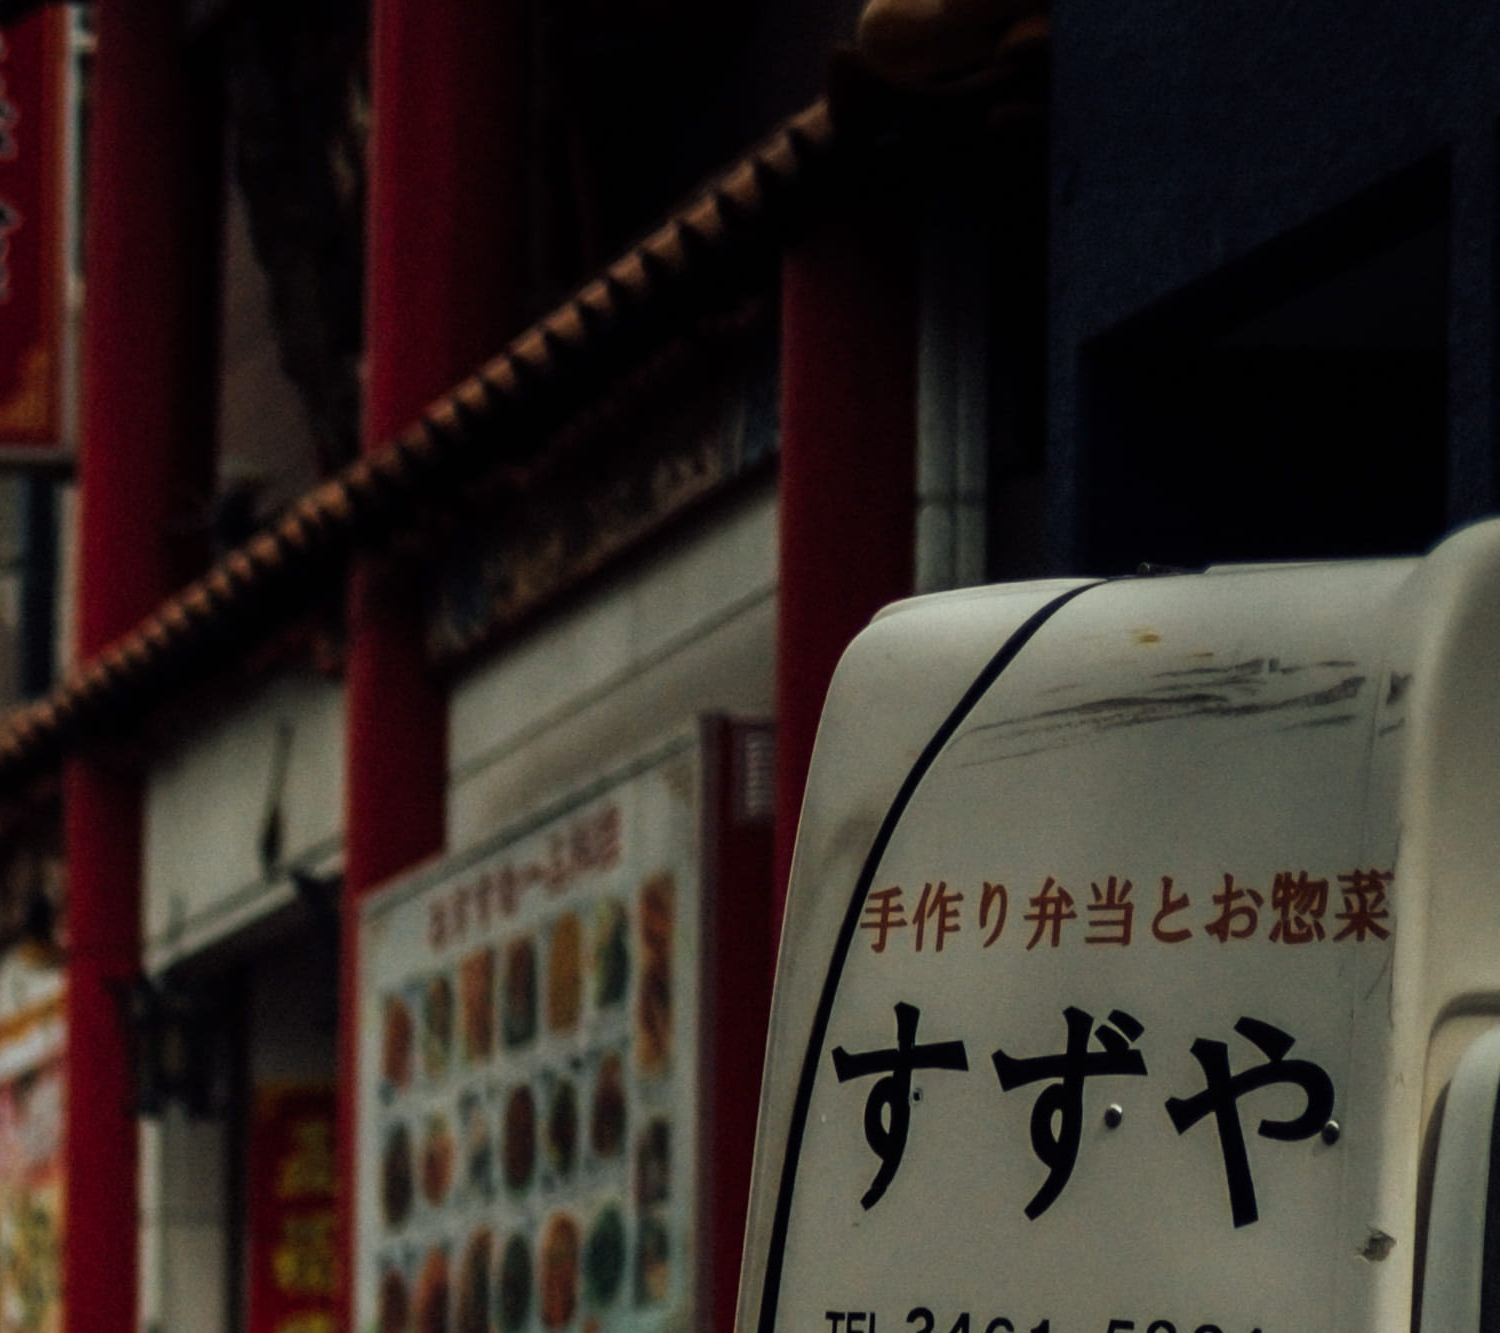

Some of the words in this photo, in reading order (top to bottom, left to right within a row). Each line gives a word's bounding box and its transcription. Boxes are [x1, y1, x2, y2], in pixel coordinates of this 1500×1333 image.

[859, 867, 1395, 954] 手作り弁当とお惣菜
[831, 1001, 1336, 1229] すずや
